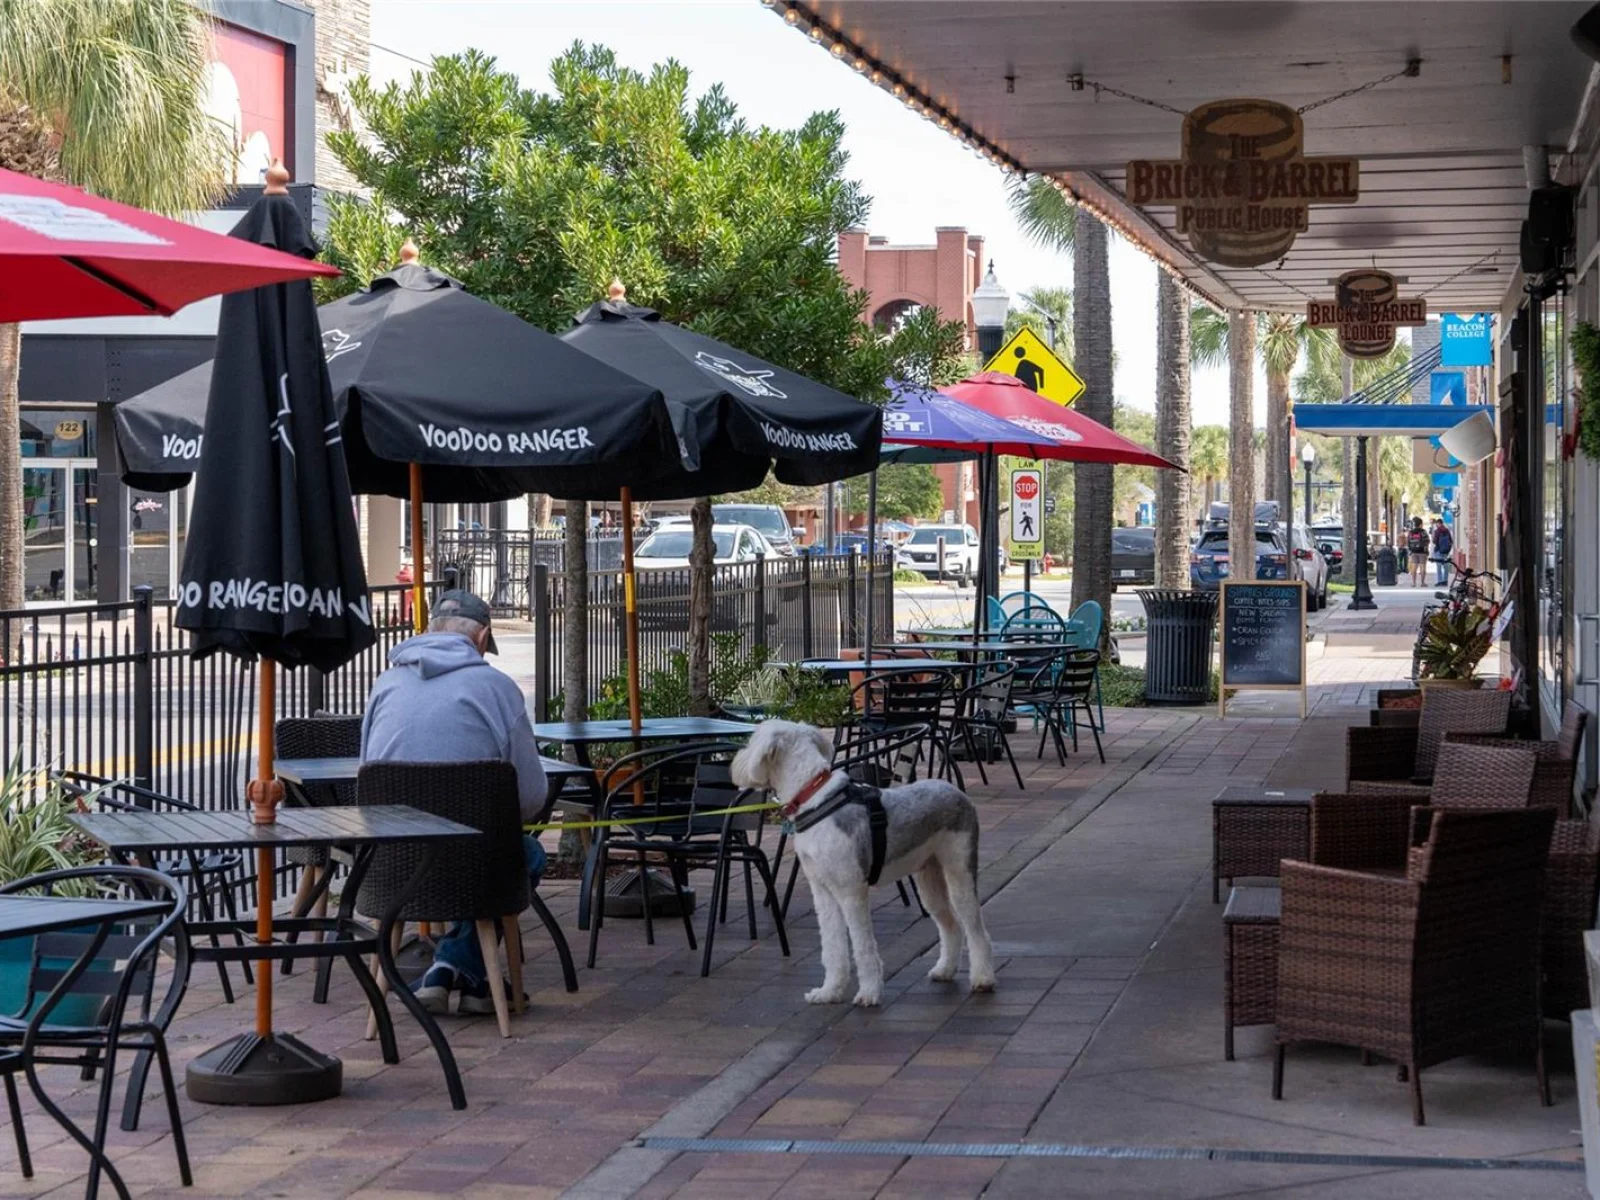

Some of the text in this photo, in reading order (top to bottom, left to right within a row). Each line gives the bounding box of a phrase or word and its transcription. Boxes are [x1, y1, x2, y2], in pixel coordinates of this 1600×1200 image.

[1228, 134, 1261, 159] THE
[1133, 160, 1358, 203] BRICK & BARREL
[1182, 205, 1305, 233] PUBLIC HOUSE
[1359, 290, 1376, 301] THE
[1310, 303, 1358, 325] BRICK
[1371, 303, 1425, 324] BARREL
[1343, 324, 1392, 341] LOUNGE
[1447, 323, 1485, 331] BEACON
[60, 422, 78, 432] 122
[419, 423, 595, 453] VOODOO RANGER
[760, 422, 858, 452] VOODOO RANGER
[1016, 483, 1037, 493] STOP
